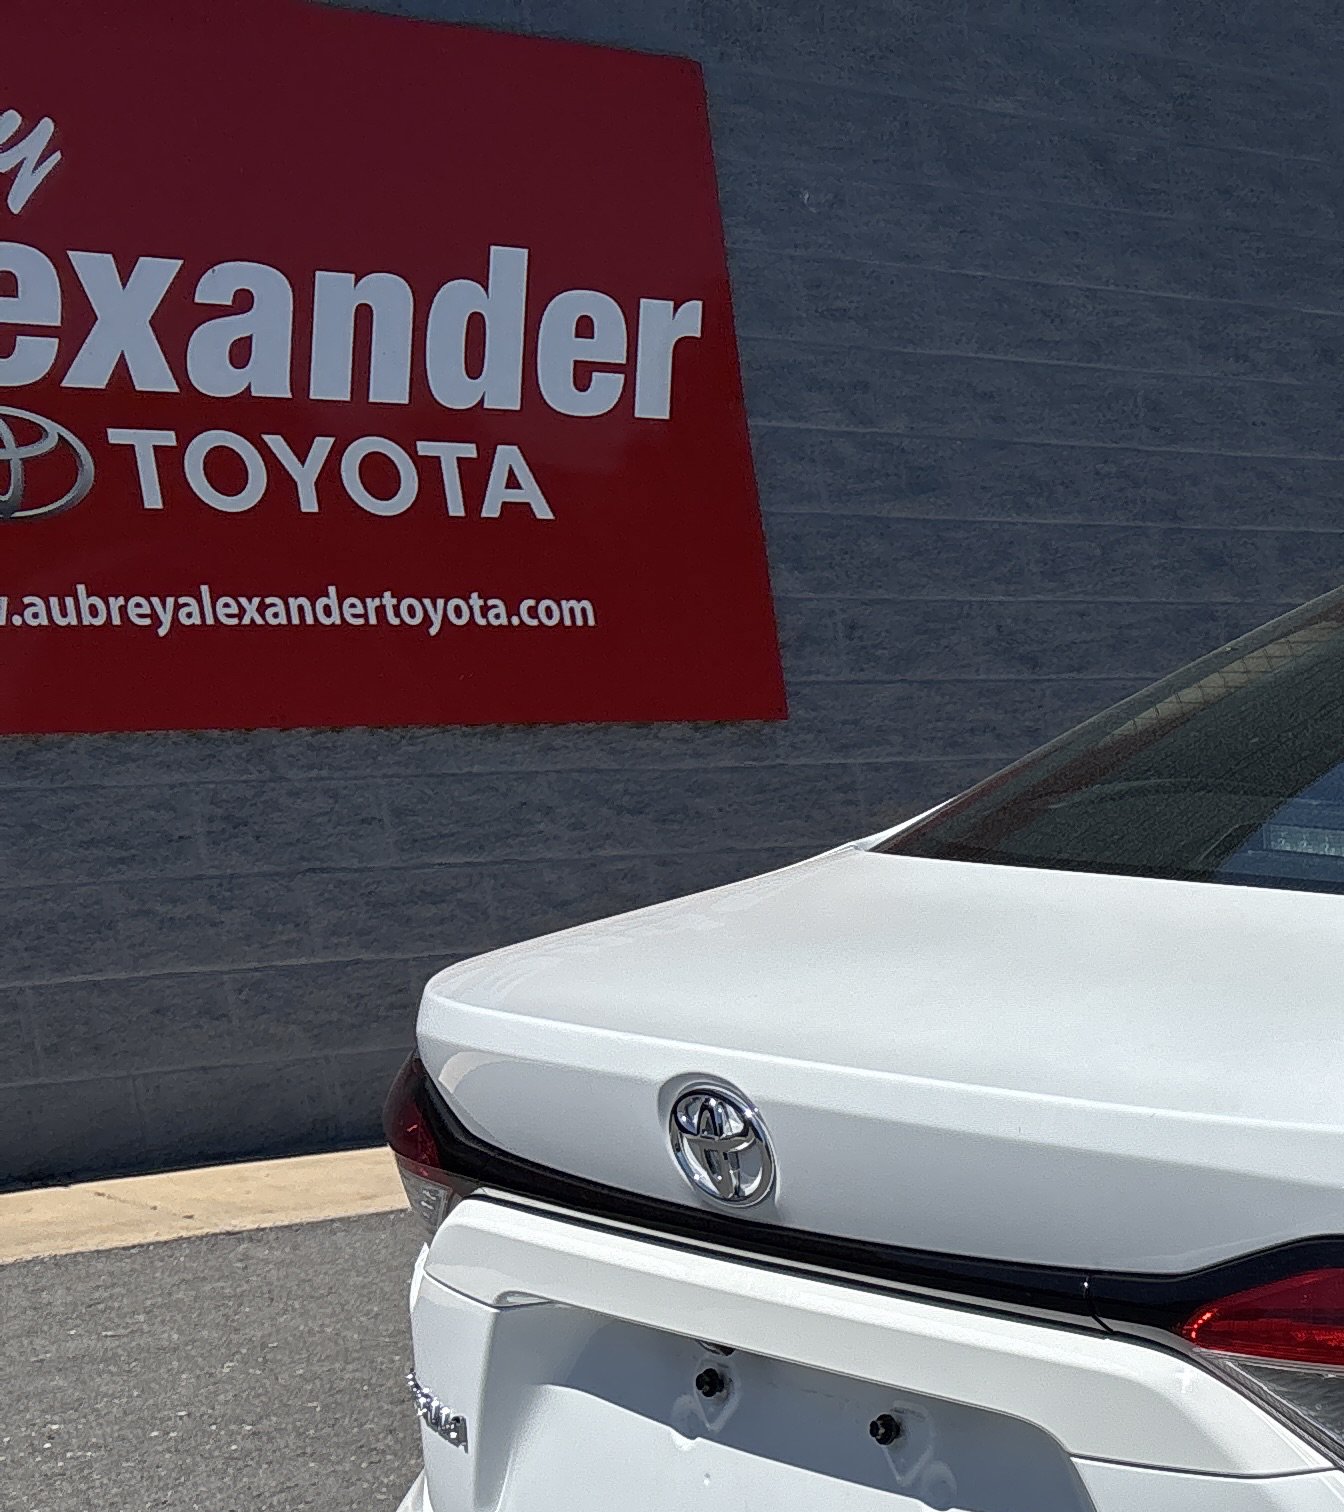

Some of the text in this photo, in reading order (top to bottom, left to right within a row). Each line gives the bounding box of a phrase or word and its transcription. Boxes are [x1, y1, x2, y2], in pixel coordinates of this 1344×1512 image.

[0, 108, 62, 215] y
[106, 428, 555, 520] TOYOTA
[0, 583, 596, 637] .aubreyalexandertoyota.com
